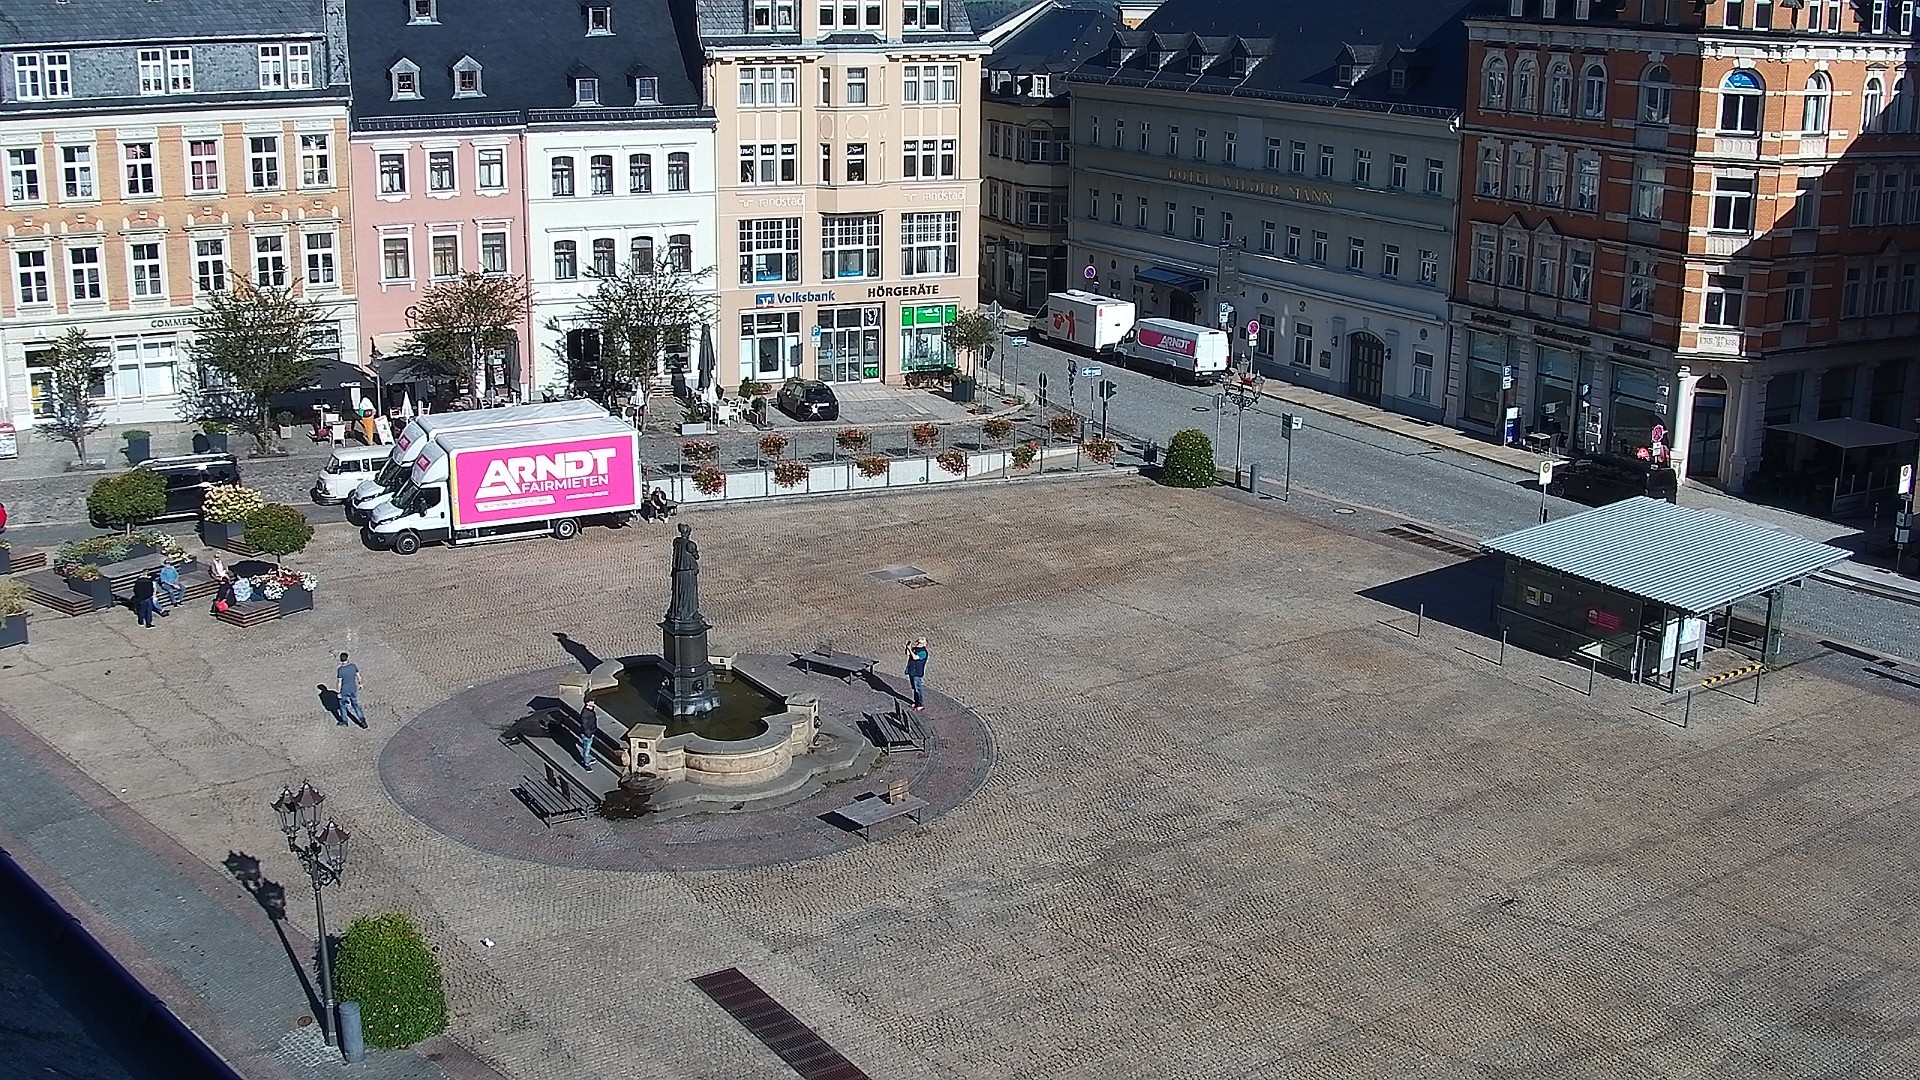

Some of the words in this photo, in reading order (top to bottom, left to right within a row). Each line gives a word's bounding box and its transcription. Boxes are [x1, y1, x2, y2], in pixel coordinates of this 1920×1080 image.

[1168, 167, 1213, 185] HOTEL
[1222, 175, 1280, 197] WILDER
[1289, 186, 1333, 205] MANN
[758, 195, 804, 208] randstad
[922, 189, 965, 201] randstad
[776, 290, 835, 304] Volksbank
[867, 284, 939, 298] HÖRGERÄTE
[1157, 335, 1191, 350] ARNDT
[475, 448, 616, 499] ARNDT
[521, 474, 609, 493] FAIRMIETEN
